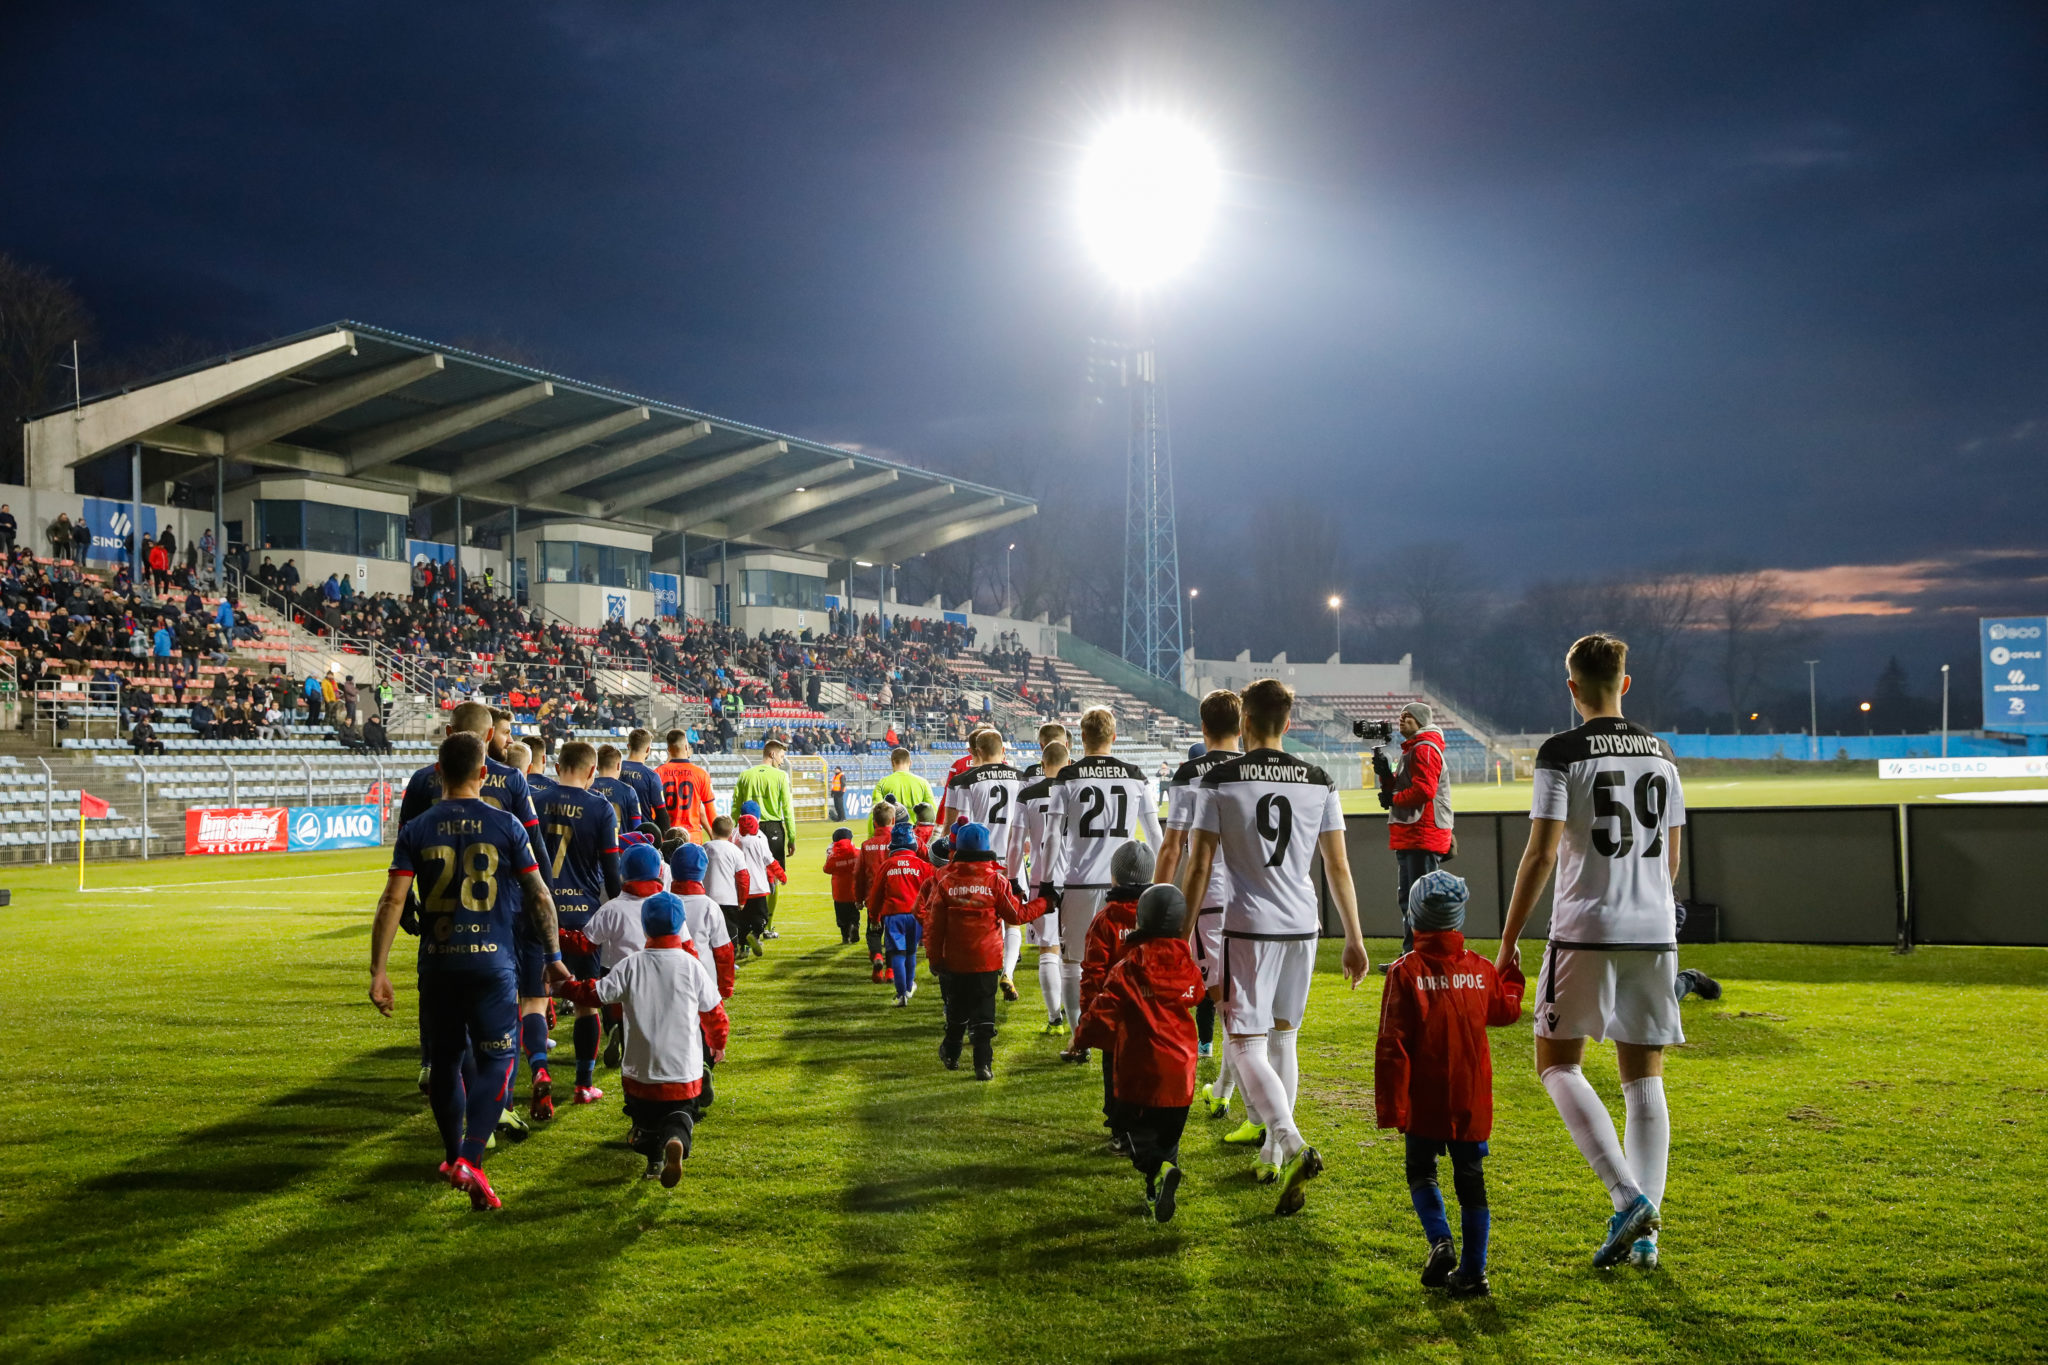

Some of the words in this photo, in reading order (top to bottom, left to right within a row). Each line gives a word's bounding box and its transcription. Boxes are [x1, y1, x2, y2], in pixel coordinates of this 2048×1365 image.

[92, 535, 126, 549] SIND
[1586, 734, 1663, 756] ZDYBOWICZ
[976, 769, 1018, 781] SZYMOREK
[1078, 766, 1129, 778] MAGIERA
[1239, 764, 1309, 783] WOŁKOWICZ
[1908, 763, 1988, 773] SINDBAD
[543, 802, 584, 819] JANUS
[988, 785, 1009, 824] 2
[1079, 785, 1129, 838] 21
[1591, 770, 1667, 859] 59
[324, 814, 373, 840] JAKO
[437, 819, 483, 836] PIECH
[1255, 792, 1293, 868] 9
[547, 823, 574, 879] 7
[420, 843, 499, 912] 28
[554, 888, 584, 896] OPOLE
[454, 924, 492, 933] OPOLE
[438, 943, 498, 953] SINDBAD
